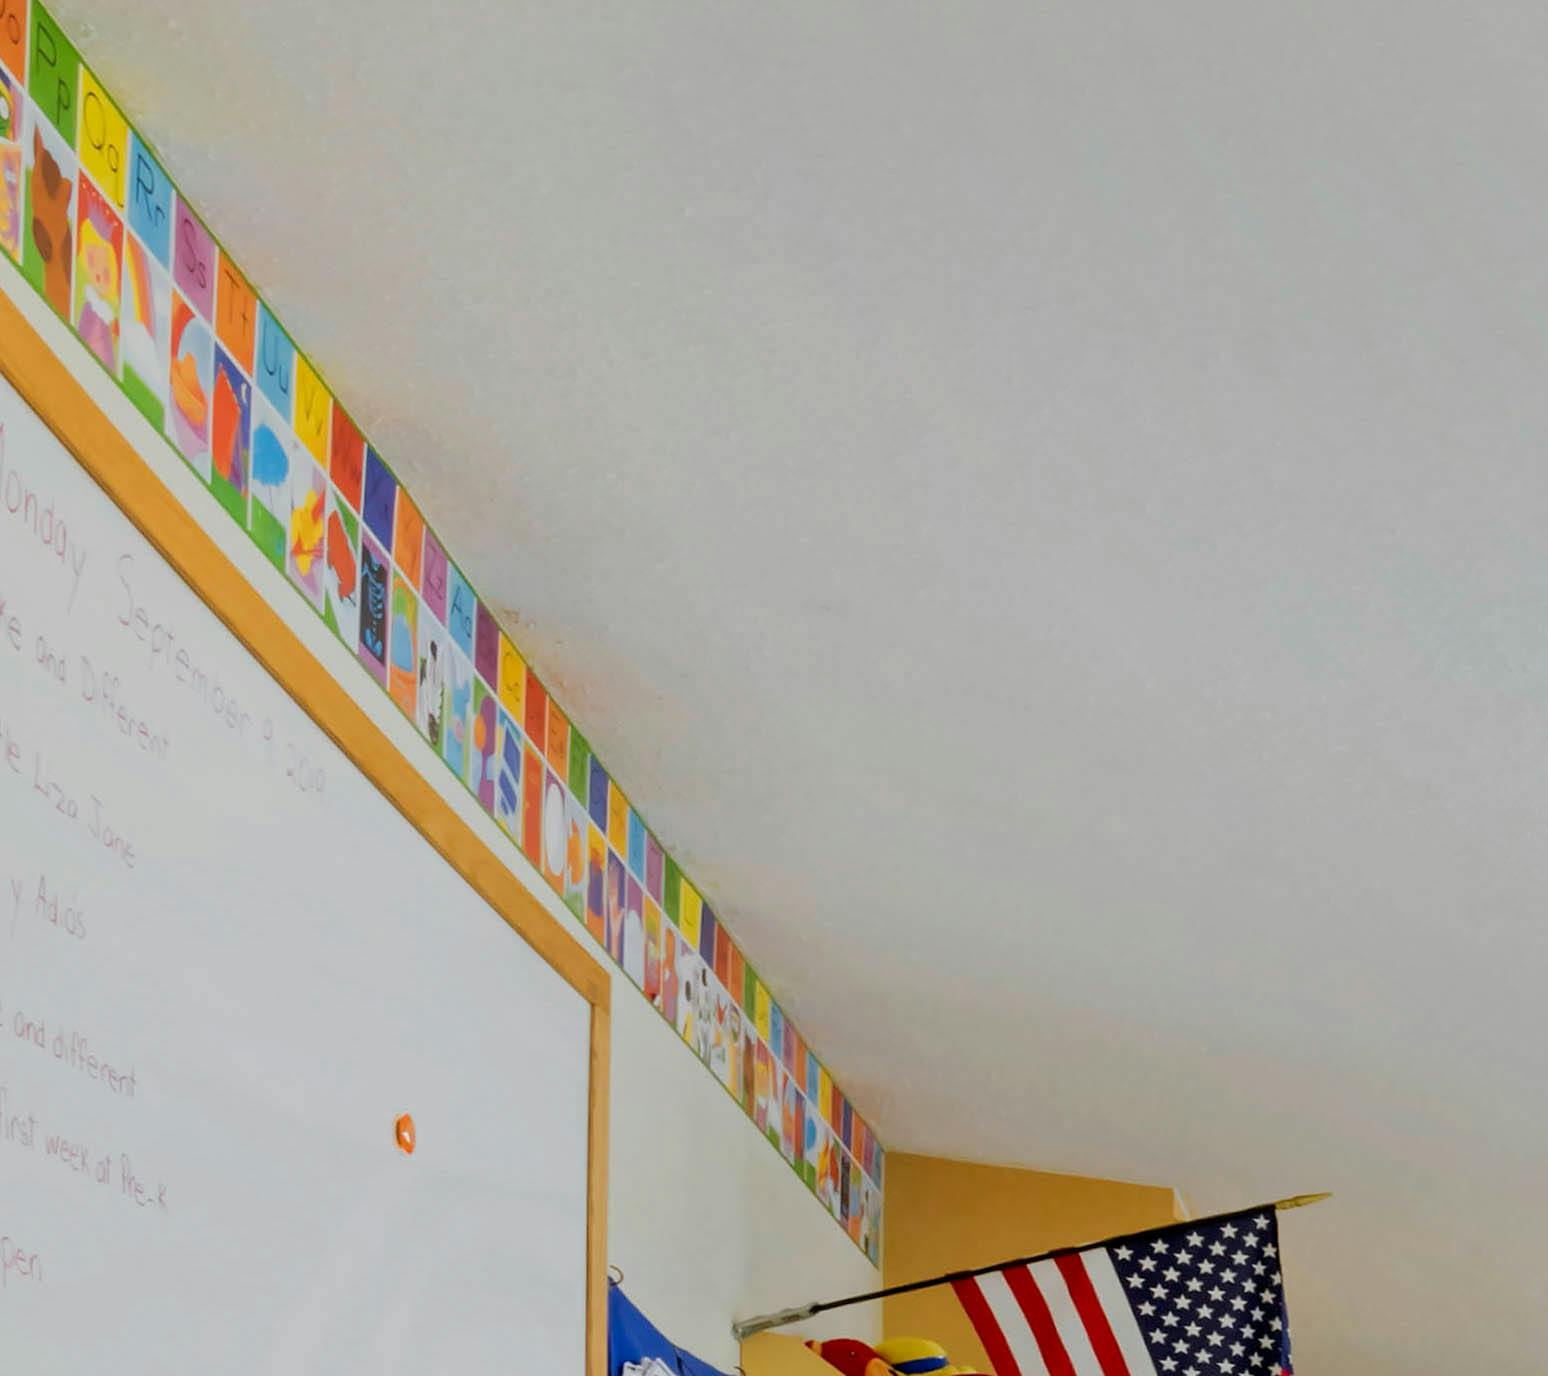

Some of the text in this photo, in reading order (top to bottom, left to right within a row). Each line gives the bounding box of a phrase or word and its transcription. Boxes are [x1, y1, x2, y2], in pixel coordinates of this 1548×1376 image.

[35, 22, 71, 126] Pp
[82, 92, 124, 208] Qq
[136, 153, 167, 227] Rr
[184, 218, 207, 289] Ss
[263, 328, 289, 395] Uu
[0, 418, 86, 616] onday
